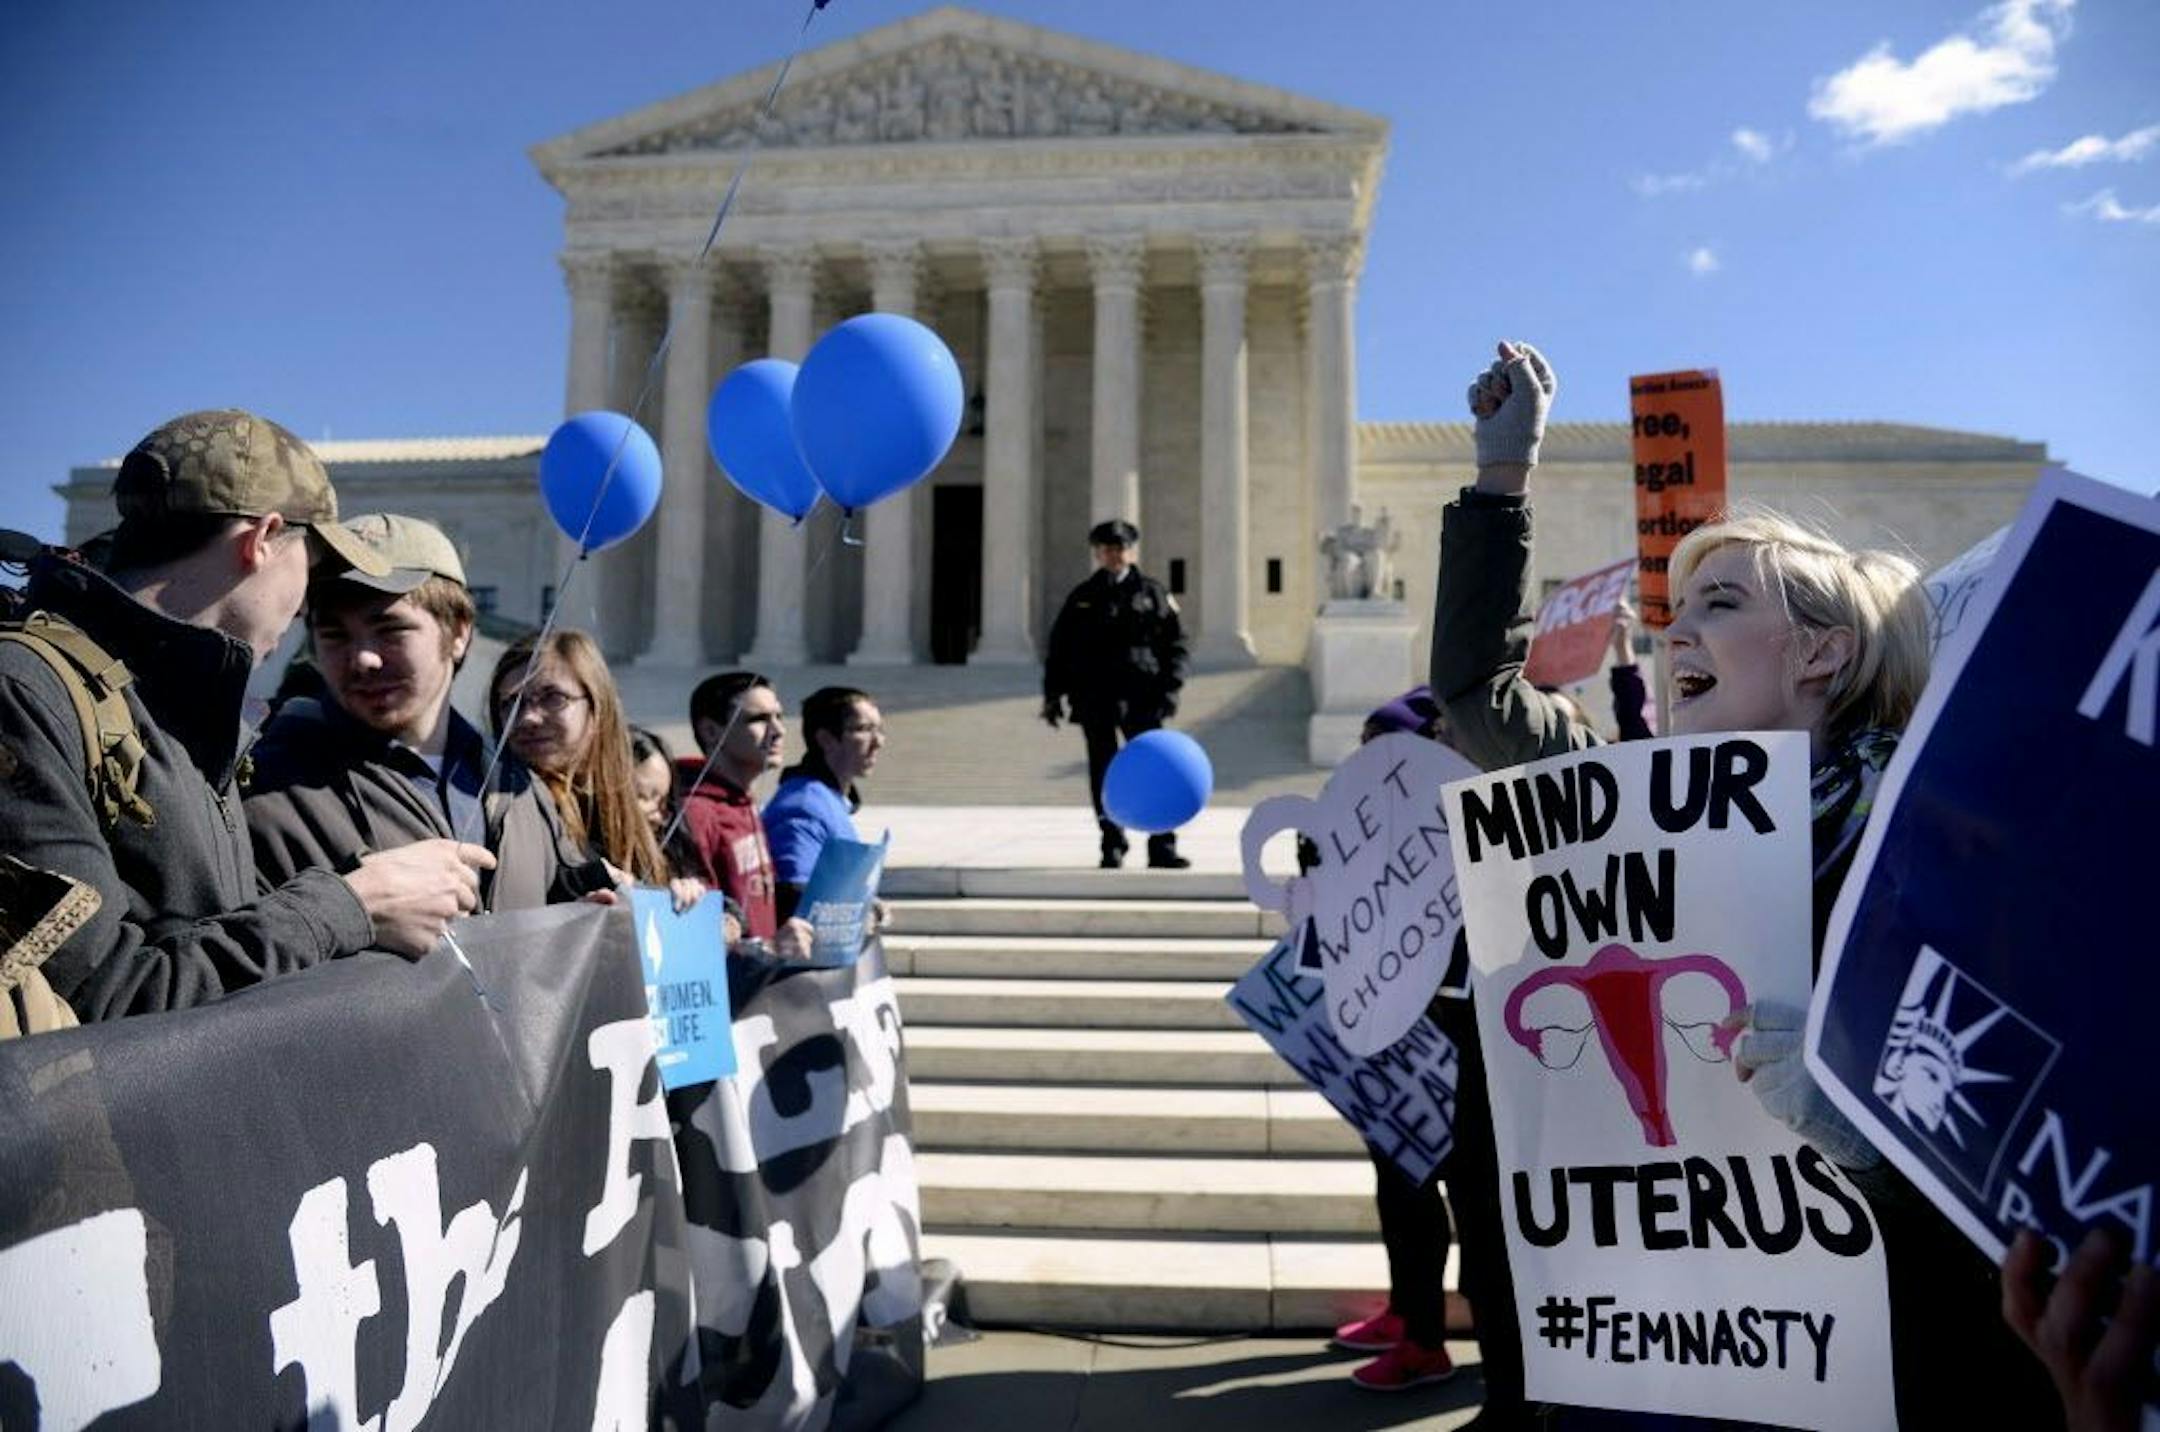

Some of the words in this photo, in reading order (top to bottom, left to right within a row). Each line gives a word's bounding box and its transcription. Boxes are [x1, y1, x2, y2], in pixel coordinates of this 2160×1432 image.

[1330, 759, 1407, 865] LET
[1460, 760, 1618, 862] MIND
[1649, 740, 1776, 834] UR
[1318, 805, 1449, 964] WOMEN
[1526, 849, 1676, 959] OWN
[1235, 947, 1325, 1034] WE
[1338, 873, 1463, 1030] CHOOSE
[670, 1013, 707, 1047] LIFE.
[1513, 1145, 1874, 1257] UTERUS
[1536, 1296, 1835, 1383] #FEMNASTY
